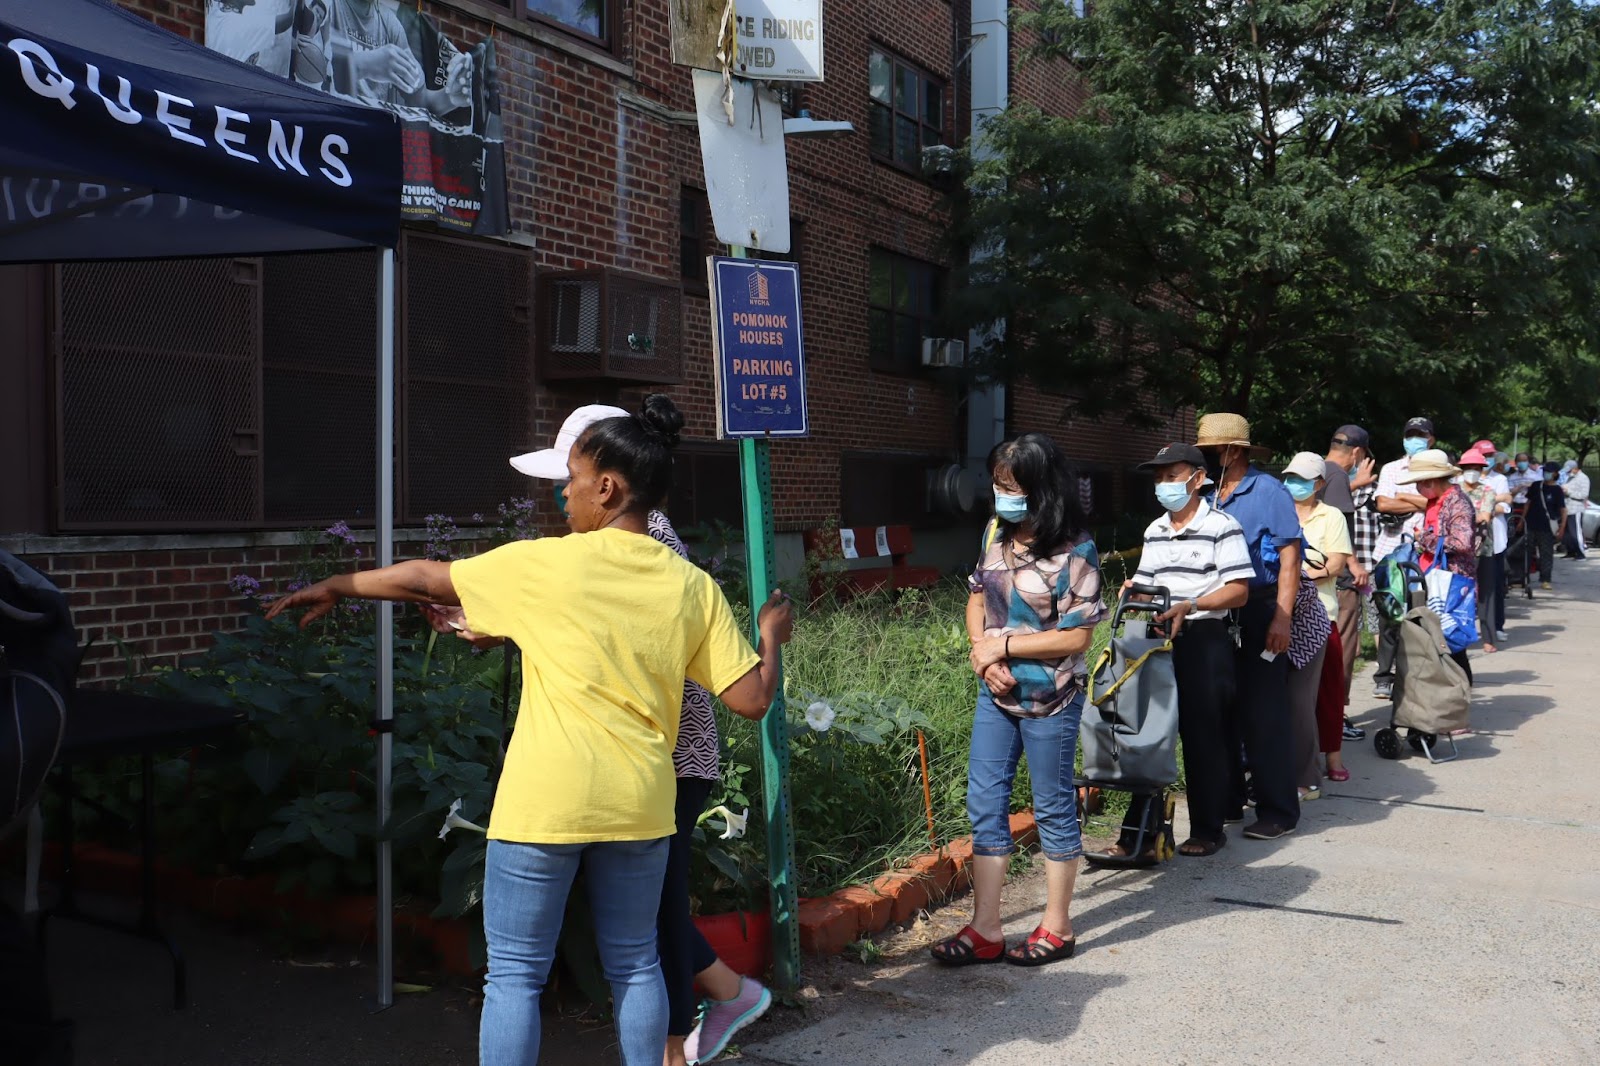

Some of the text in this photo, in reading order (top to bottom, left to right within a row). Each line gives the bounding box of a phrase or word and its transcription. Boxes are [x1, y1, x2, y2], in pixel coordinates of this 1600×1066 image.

[736, 15, 815, 41] LE RIDING
[7, 38, 353, 187] QUEENS
[448, 198, 472, 209] CAN
[732, 312, 788, 329] POMONOK
[739, 330, 784, 346] HOUSES
[732, 358, 793, 376] PARKING
[741, 383, 787, 400] LOT #5
